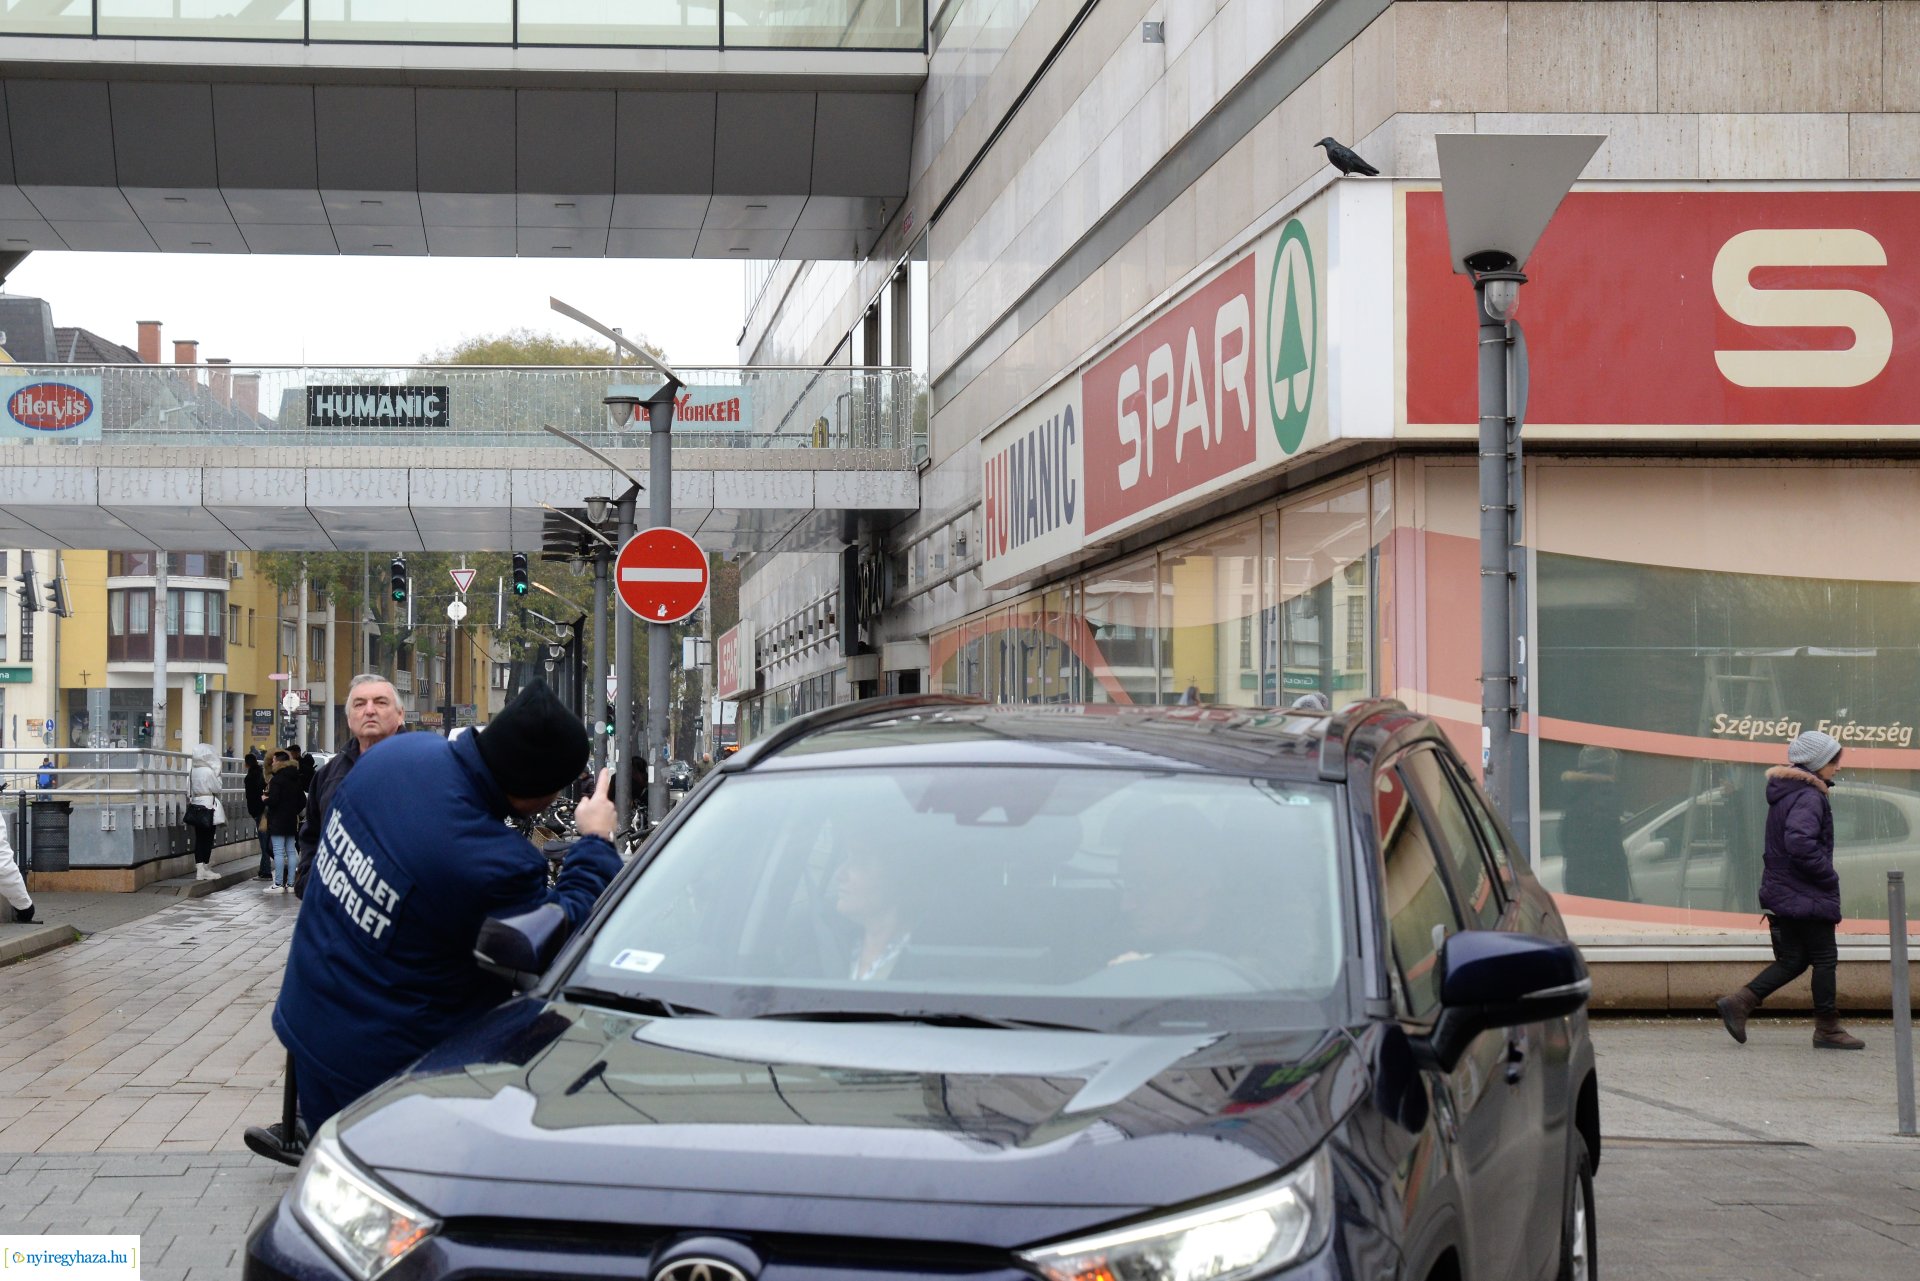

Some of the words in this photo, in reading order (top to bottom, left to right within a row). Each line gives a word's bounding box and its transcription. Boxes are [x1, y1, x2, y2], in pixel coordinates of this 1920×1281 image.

[17, 393, 86, 420] Hervis
[316, 394, 440, 418] HUMANIC
[1117, 293, 1251, 491] SPAR
[984, 403, 1076, 562] HUMANIC
[1712, 713, 1802, 743] Szépség
[315, 838, 392, 940] FELÜGYELET
[326, 808, 400, 914] ÖZTERÜLET
